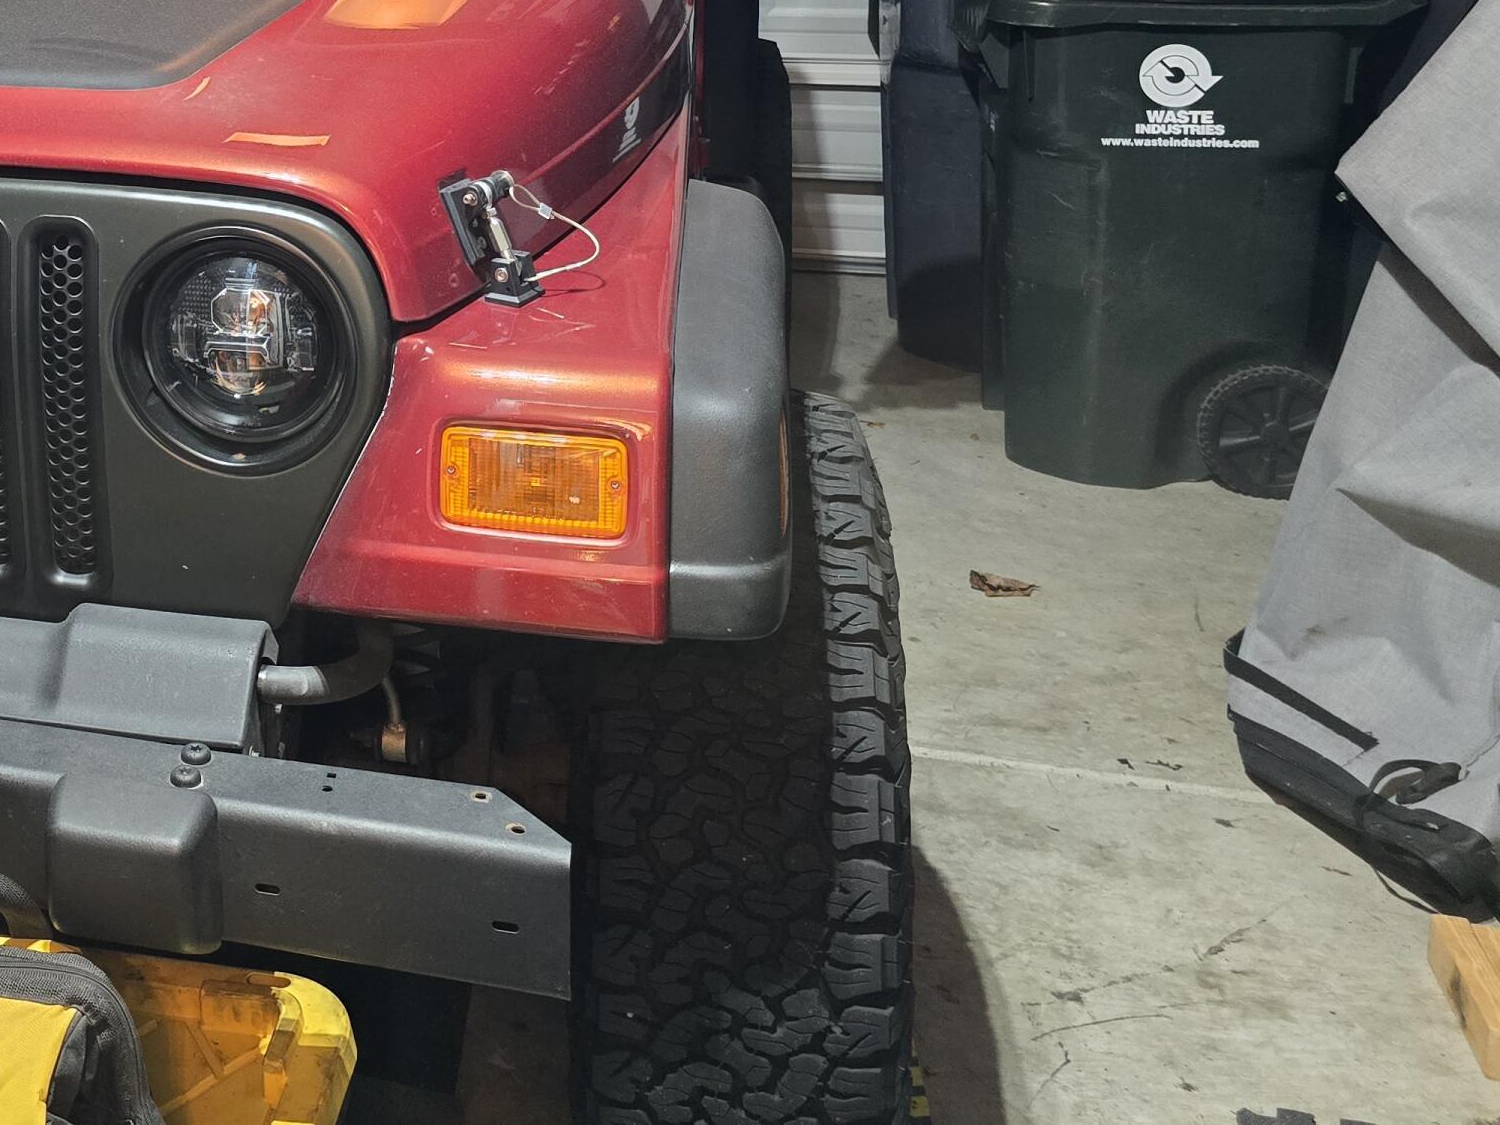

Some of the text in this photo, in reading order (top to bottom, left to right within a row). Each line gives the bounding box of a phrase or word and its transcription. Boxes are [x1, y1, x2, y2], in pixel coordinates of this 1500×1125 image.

[1146, 110, 1215, 124] WASTE
[1134, 123, 1226, 136] INDUSTRIES
[1100, 137, 1260, 149] www.wasteindustries.com
